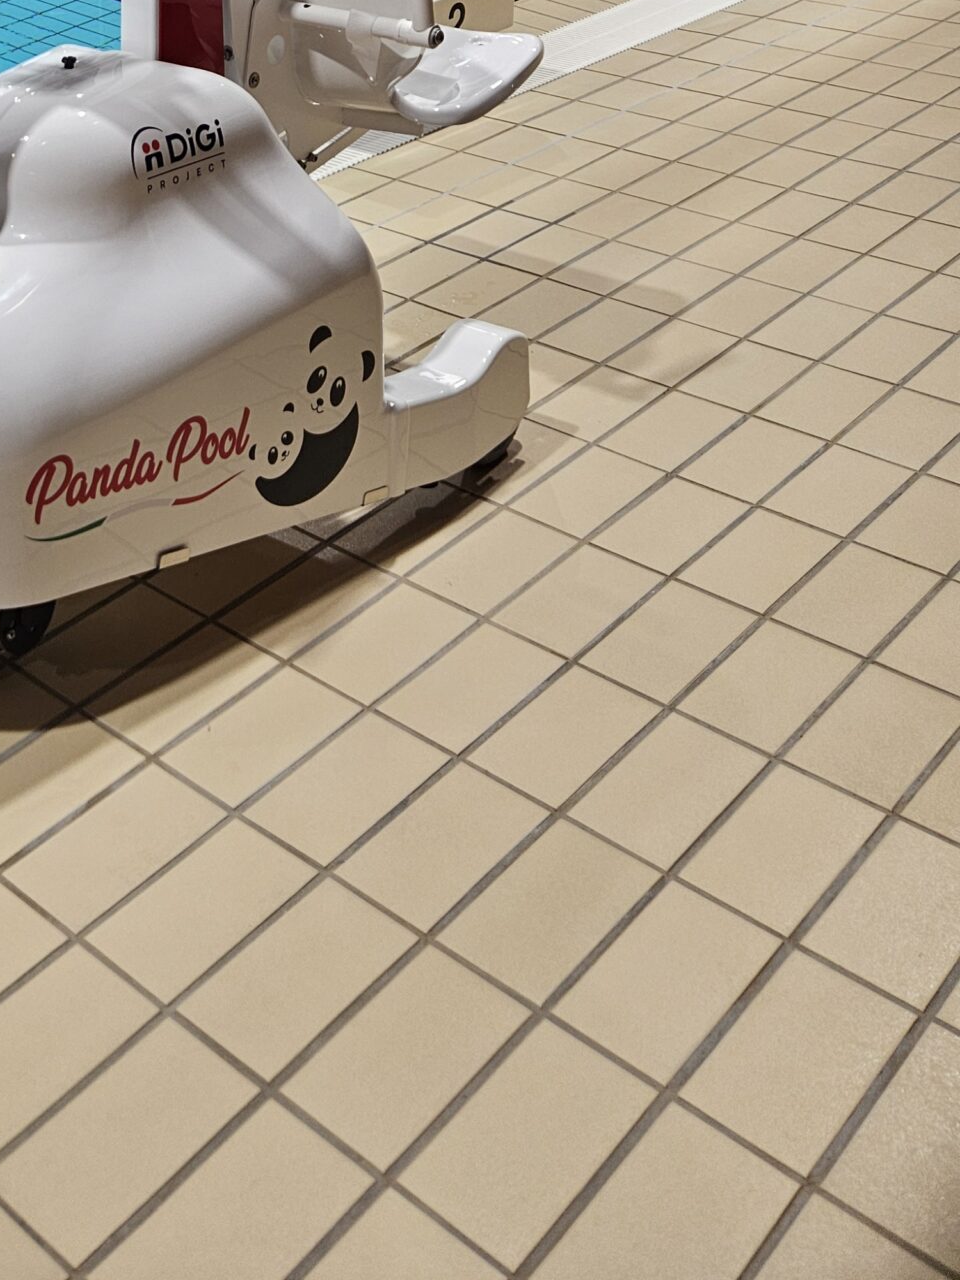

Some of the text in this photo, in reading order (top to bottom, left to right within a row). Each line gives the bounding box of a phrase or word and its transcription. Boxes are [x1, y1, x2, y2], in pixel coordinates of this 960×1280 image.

[448, 2, 466, 29] 2
[146, 159, 228, 195] PROJECT
[24, 406, 251, 525] Panda Pool
